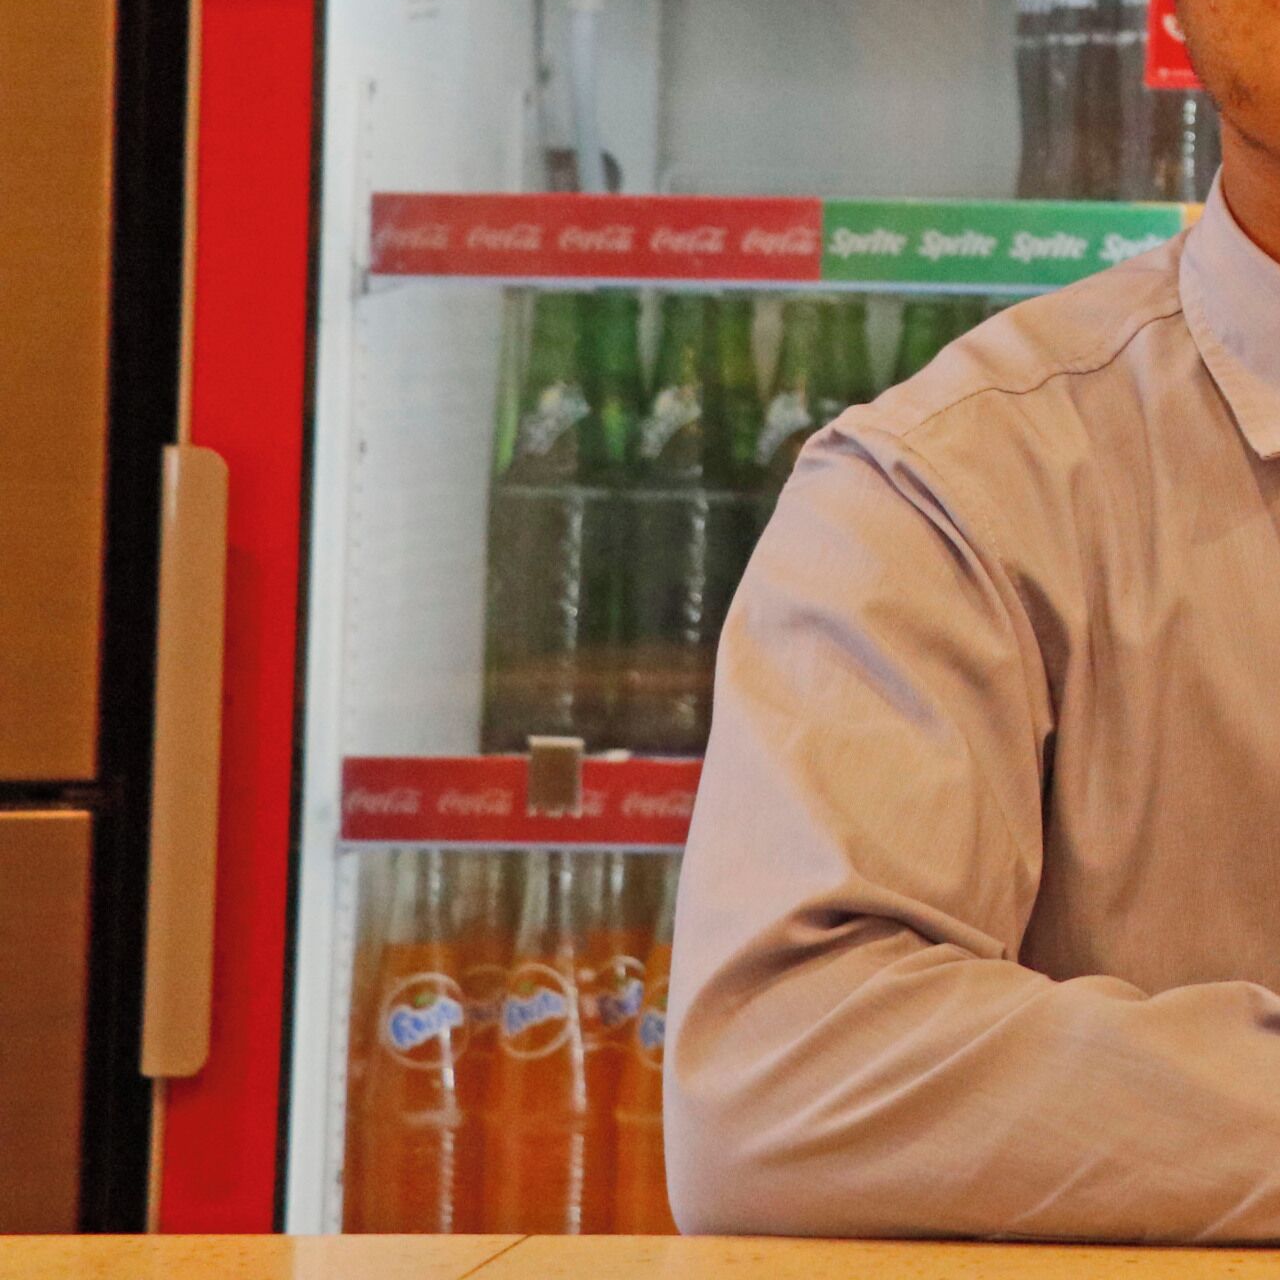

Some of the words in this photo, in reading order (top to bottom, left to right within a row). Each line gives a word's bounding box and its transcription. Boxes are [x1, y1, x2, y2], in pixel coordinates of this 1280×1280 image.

[830, 228, 907, 260] Sprite
[918, 229, 997, 262] Sprite
[1009, 229, 1089, 263] Sprite
